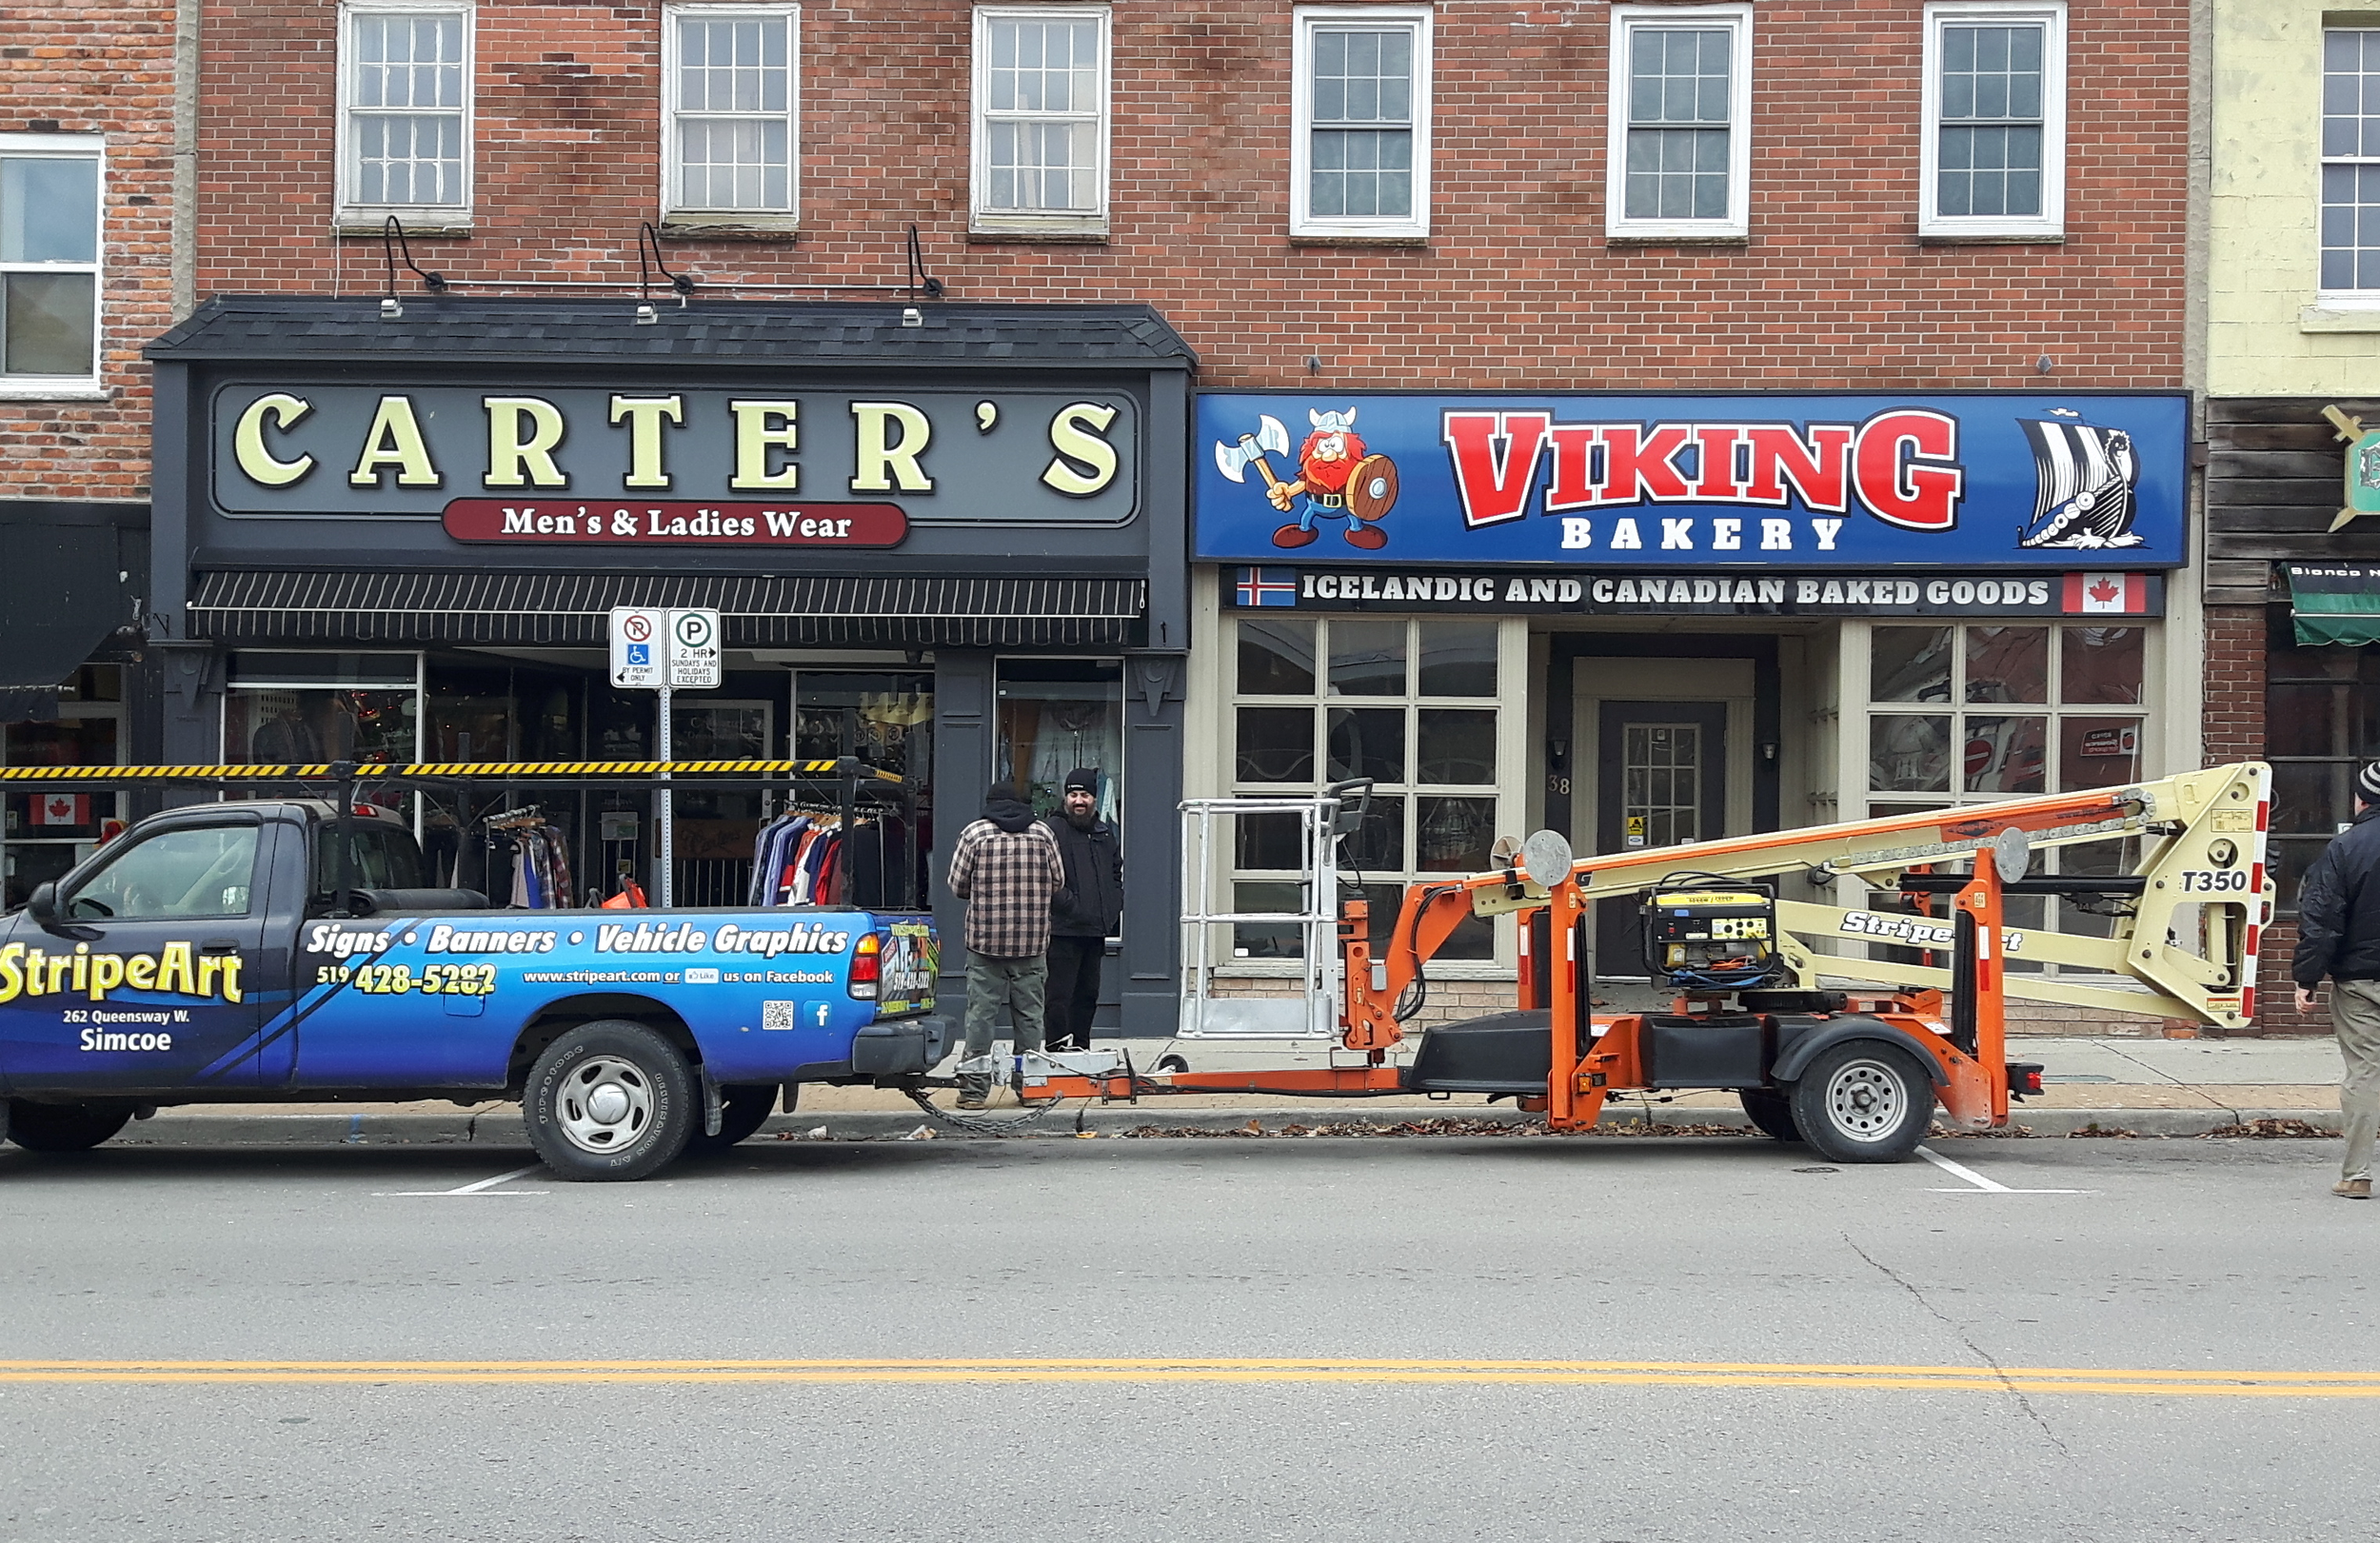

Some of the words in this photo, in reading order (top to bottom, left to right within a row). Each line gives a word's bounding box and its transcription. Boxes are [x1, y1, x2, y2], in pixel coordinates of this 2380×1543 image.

[233, 391, 1121, 498] CARTER'S
[1442, 407, 1963, 531] VIKING
[502, 505, 601, 536] Men's
[612, 509, 638, 536] &
[647, 509, 755, 537] Ladies
[763, 511, 852, 538] Wear
[1561, 518, 1841, 549] BAKERY
[1302, 575, 1494, 602] ICELANDIC
[1506, 579, 1582, 603] AND
[1592, 579, 1784, 604] CANADIAN
[1796, 580, 1919, 604] BAKED
[1926, 581, 2049, 605] GOODS
[686, 622, 702, 640] P
[681, 648, 687, 658] 2
[693, 648, 707, 658] HR
[1548, 774, 1570, 795] 38
[2181, 870, 2247, 893] T350
[307, 923, 390, 958] Signs
[426, 924, 556, 954] Banners
[595, 922, 706, 953] Vehicle
[713, 922, 849, 958] Graphics
[0, 941, 243, 1004] StripeArt
[316, 966, 350, 983] 519
[355, 964, 497, 994] 428-5282
[524, 970, 660, 984] www.stripeart.com
[663, 972, 680, 983] or
[699, 972, 714, 980] Like
[723, 972, 739, 982] us
[744, 972, 762, 982] on
[766, 971, 833, 983] Facebook
[63, 1010, 88, 1023] 262
[92, 1010, 169, 1025] Queensway
[173, 1010, 190, 1022] W.
[80, 1027, 171, 1051] Simcoe
